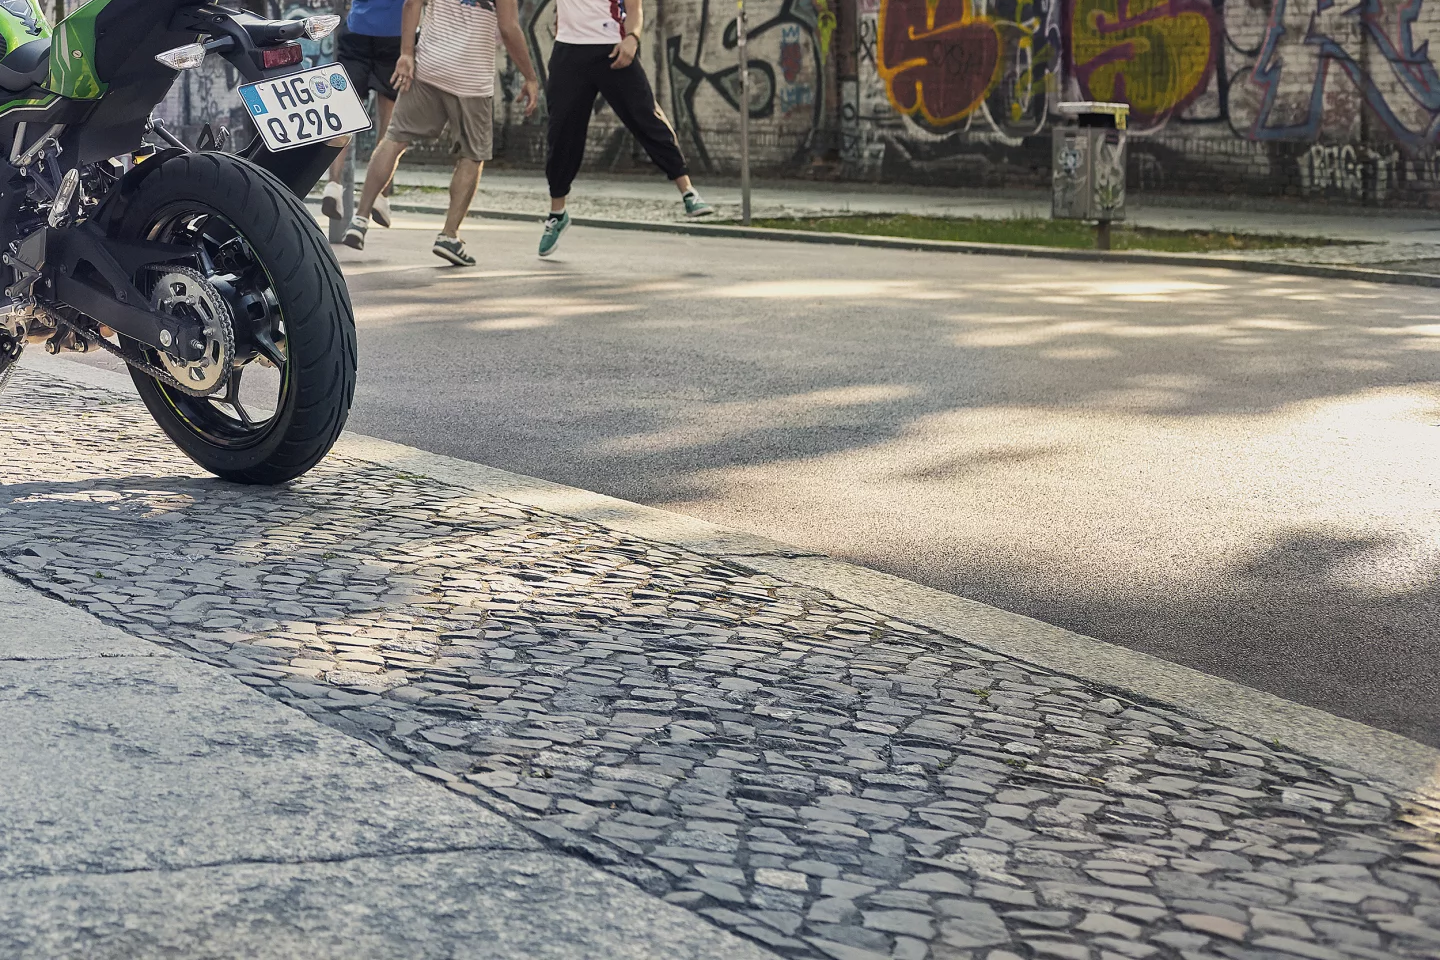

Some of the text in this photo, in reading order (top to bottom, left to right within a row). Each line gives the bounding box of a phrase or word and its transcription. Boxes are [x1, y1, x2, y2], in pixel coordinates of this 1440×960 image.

[253, 104, 262, 114] D
[271, 77, 315, 110] HG
[267, 104, 343, 144] Q 296
